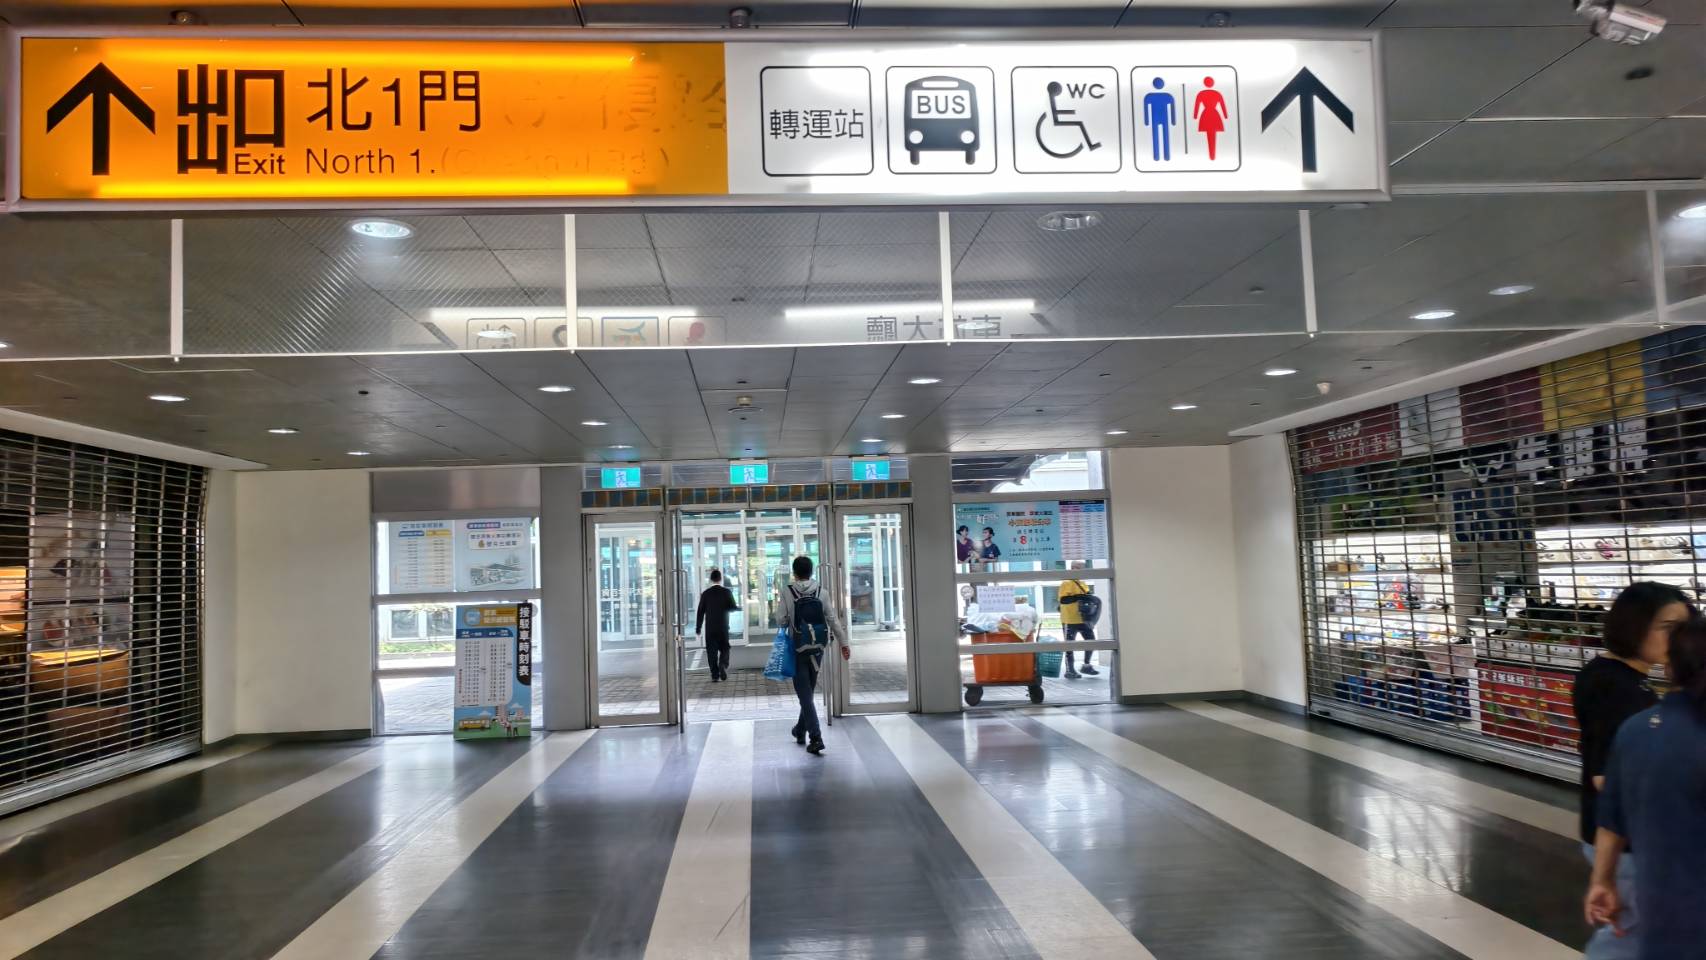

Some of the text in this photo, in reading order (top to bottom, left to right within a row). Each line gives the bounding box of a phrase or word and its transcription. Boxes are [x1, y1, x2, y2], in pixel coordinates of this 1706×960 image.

[1067, 81, 1106, 99] WC
[176, 63, 286, 175] 出口
[306, 67, 481, 132] 北1門
[916, 95, 967, 115] BUS
[770, 109, 865, 140] 轉運站
[234, 152, 286, 175] Exit
[305, 147, 396, 175] North
